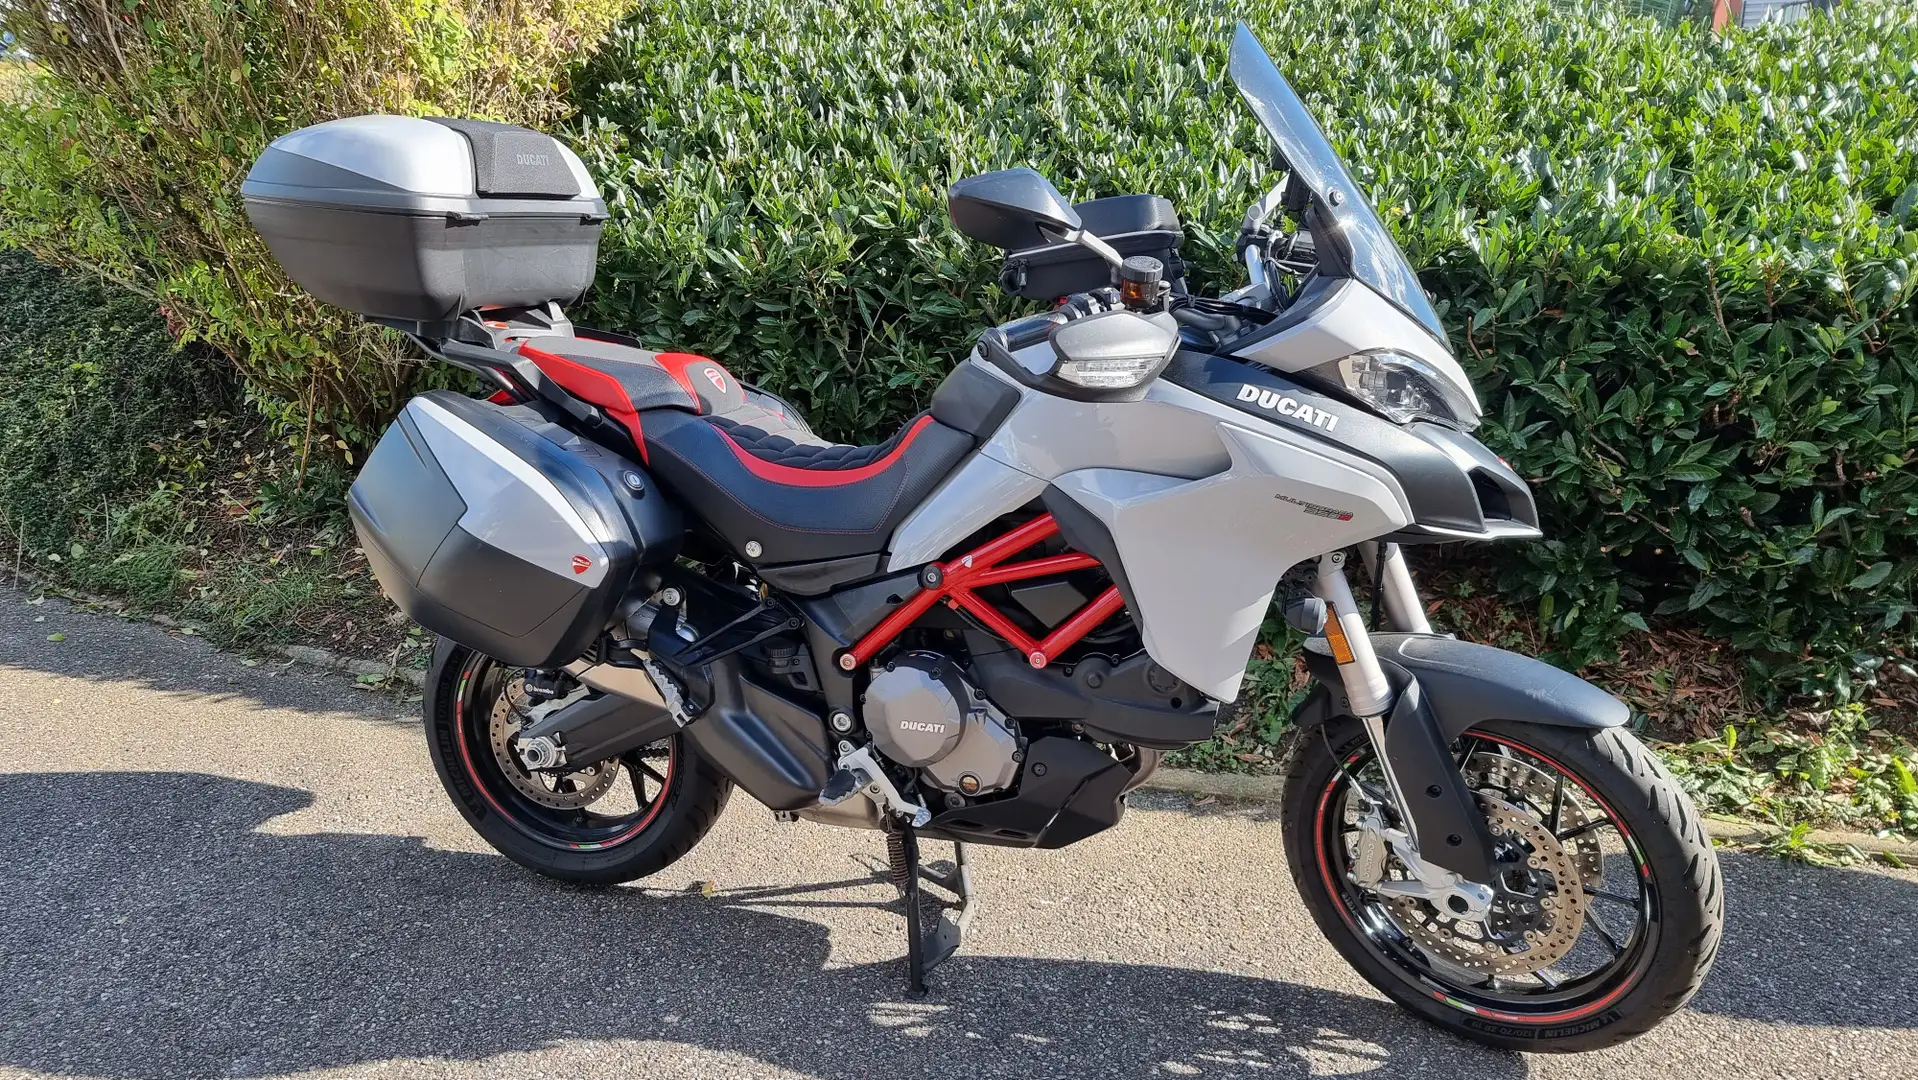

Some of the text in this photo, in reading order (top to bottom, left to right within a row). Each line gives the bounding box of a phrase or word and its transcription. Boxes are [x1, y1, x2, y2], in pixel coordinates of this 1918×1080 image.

[516, 153, 549, 166] DUCATI
[1236, 383, 1340, 432] DUCATI
[900, 720, 945, 734] DUCATI
[1363, 843, 1375, 878] brembo
[1545, 1020, 1601, 1038] MICHELIN
